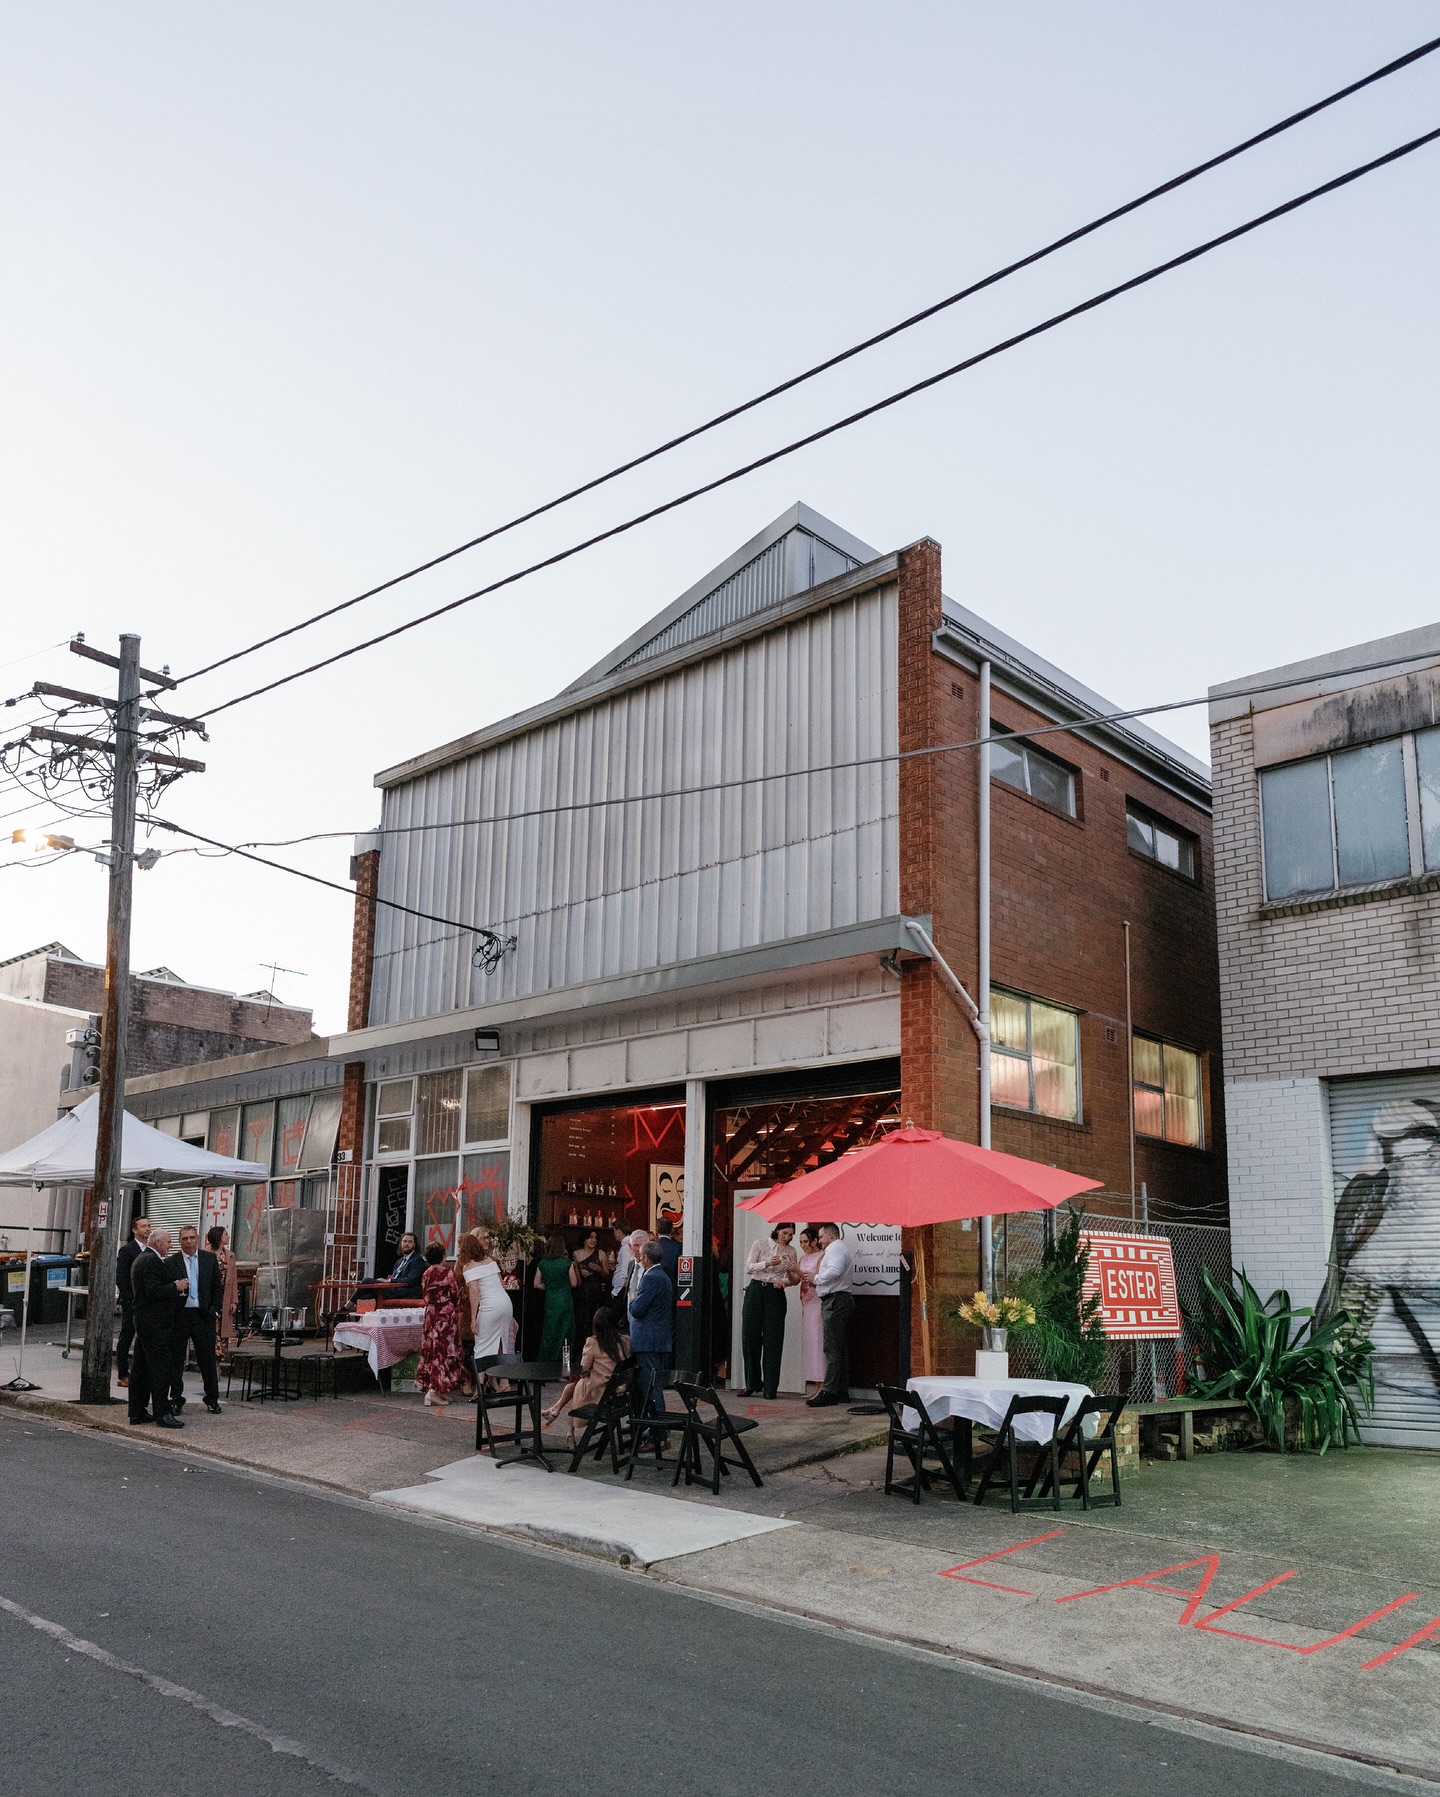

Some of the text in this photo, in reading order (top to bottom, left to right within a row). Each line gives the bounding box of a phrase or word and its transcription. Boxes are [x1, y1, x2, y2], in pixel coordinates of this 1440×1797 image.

[338, 1151, 346, 1161] 33
[856, 1233, 894, 1241] Welcome
[854, 1265, 900, 1273] Lovers Lunc
[1107, 1269, 1157, 1299] ESTER
